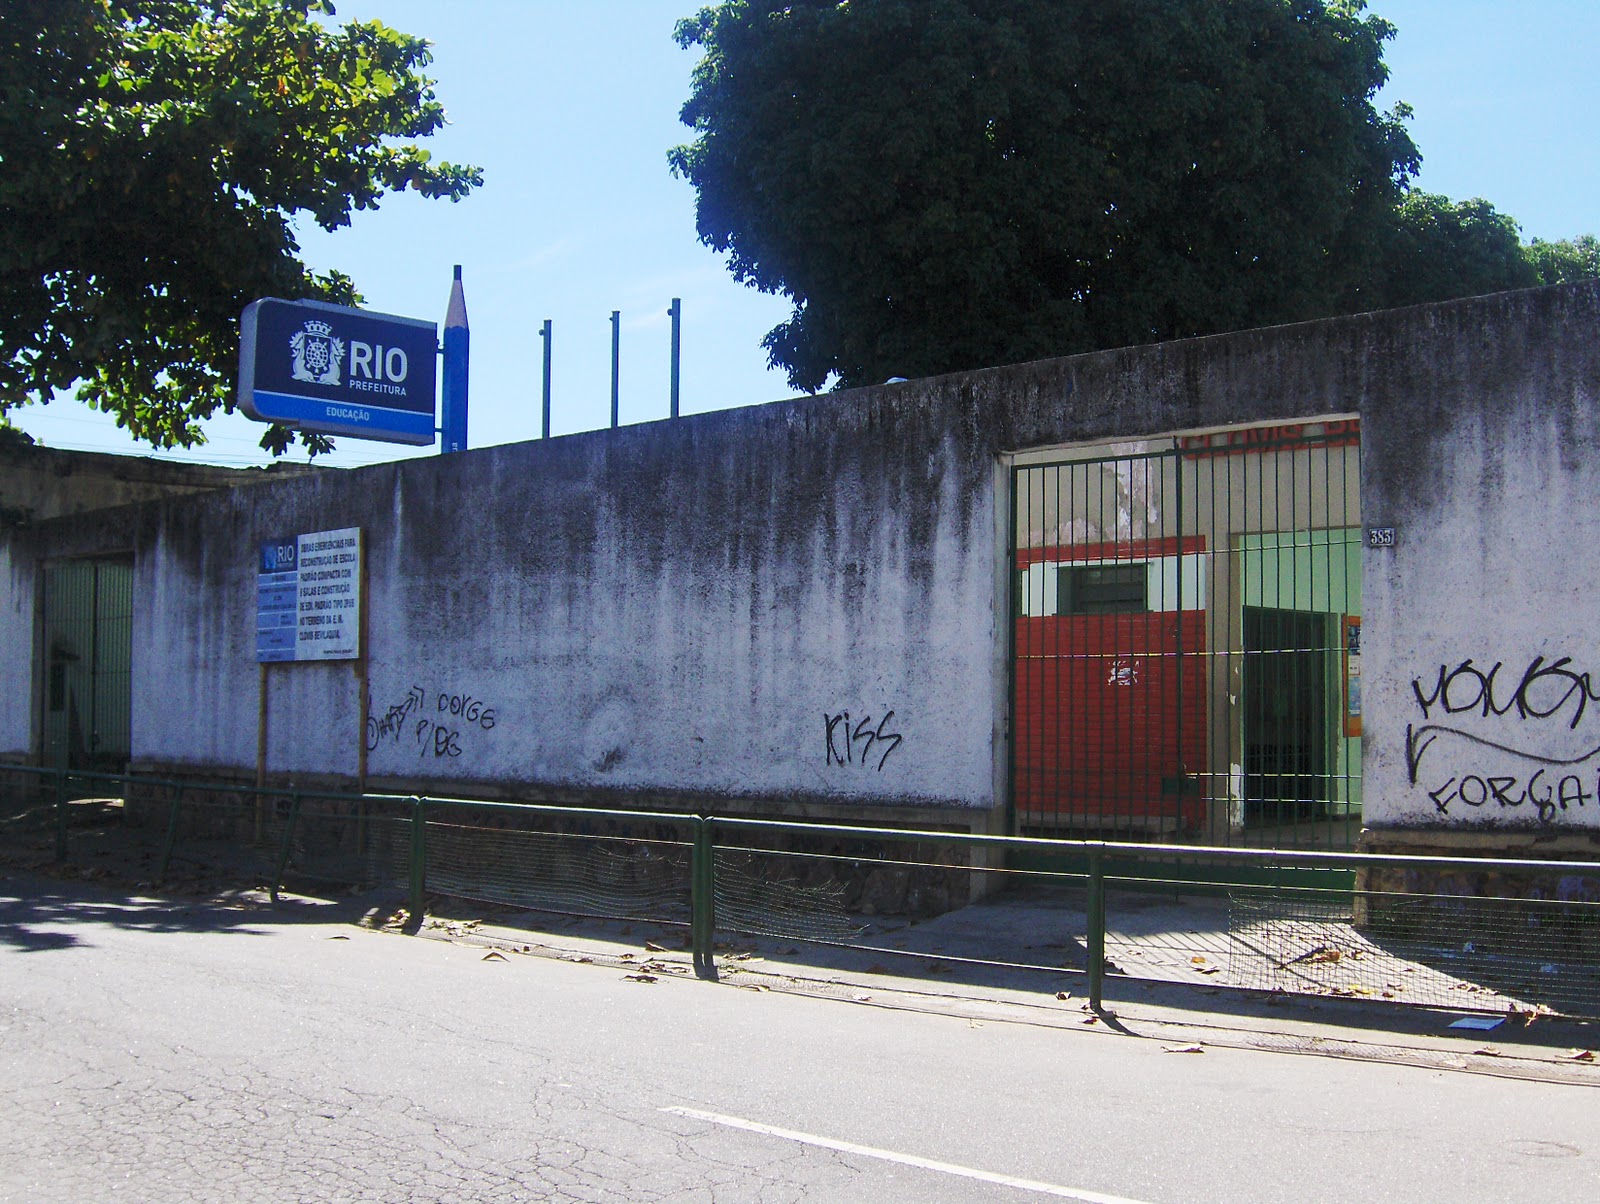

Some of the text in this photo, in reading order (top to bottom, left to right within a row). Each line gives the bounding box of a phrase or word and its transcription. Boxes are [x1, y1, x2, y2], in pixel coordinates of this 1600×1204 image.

[350, 340, 409, 384] RIO
[349, 378, 407, 397] PREFEITURA
[326, 406, 370, 422] EDUCAÇÃO
[1371, 530, 1391, 544] 383
[277, 545, 294, 562] RIO
[301, 543, 314, 553] OBRAS
[333, 554, 338, 564] DE
[340, 553, 356, 564] ESCOLA
[303, 586, 317, 597] SALAS
